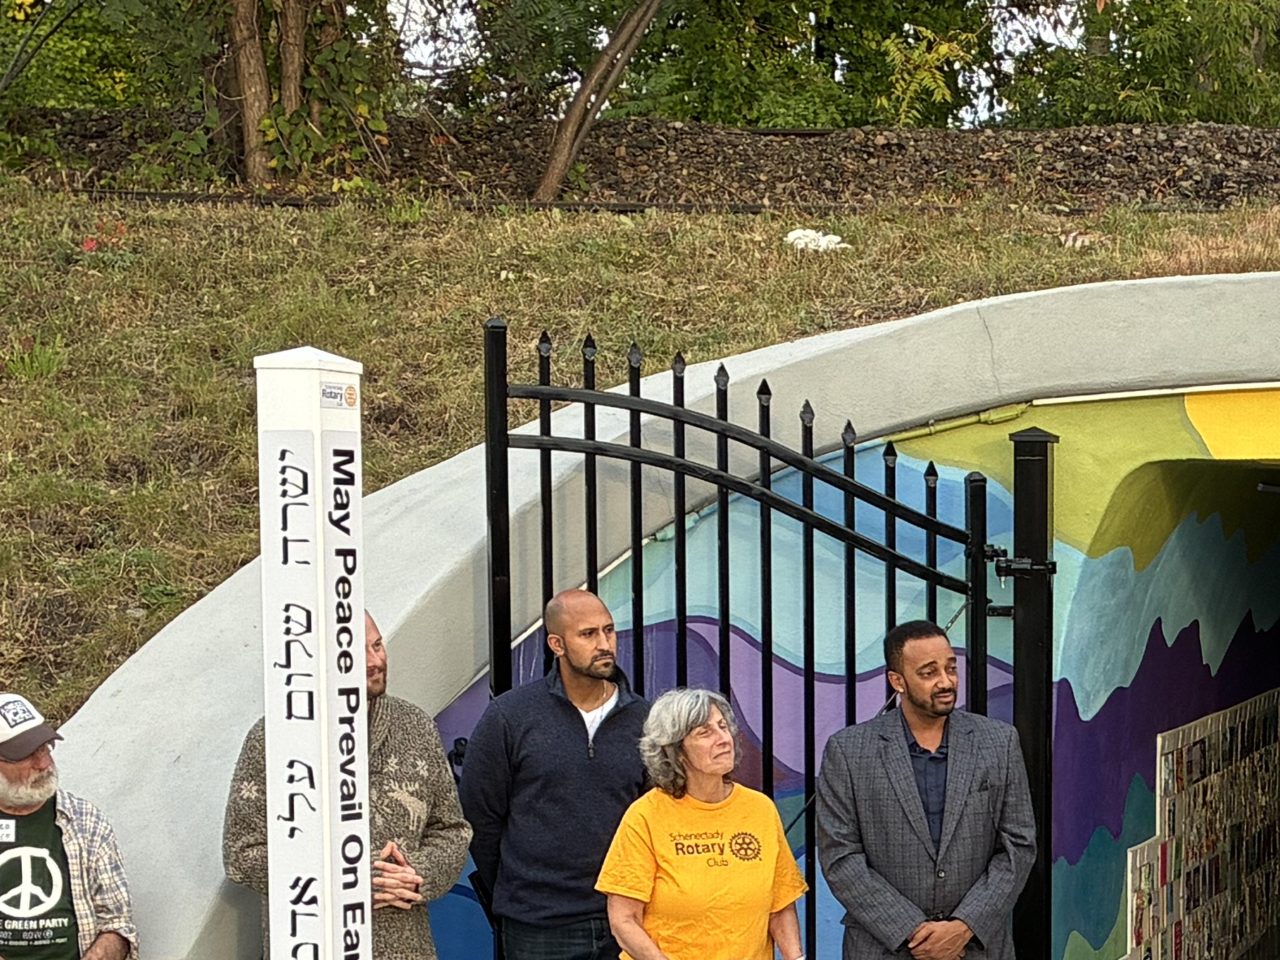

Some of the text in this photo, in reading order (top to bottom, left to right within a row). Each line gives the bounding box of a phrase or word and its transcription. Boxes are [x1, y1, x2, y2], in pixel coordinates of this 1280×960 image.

[278, 449, 310, 565] ישרה
[328, 449, 355, 536] May
[335, 549, 357, 675] Peace
[273, 603, 314, 721] שלום
[338, 687, 363, 822] Prevail
[277, 759, 316, 839] עלי
[669, 830, 724, 842] Schenectady
[341, 834, 364, 890] On
[674, 842, 725, 856] Rotary
[706, 857, 729, 868] Club
[4, 920, 38, 930] GREEN
[39, 918, 68, 929] PARTY
